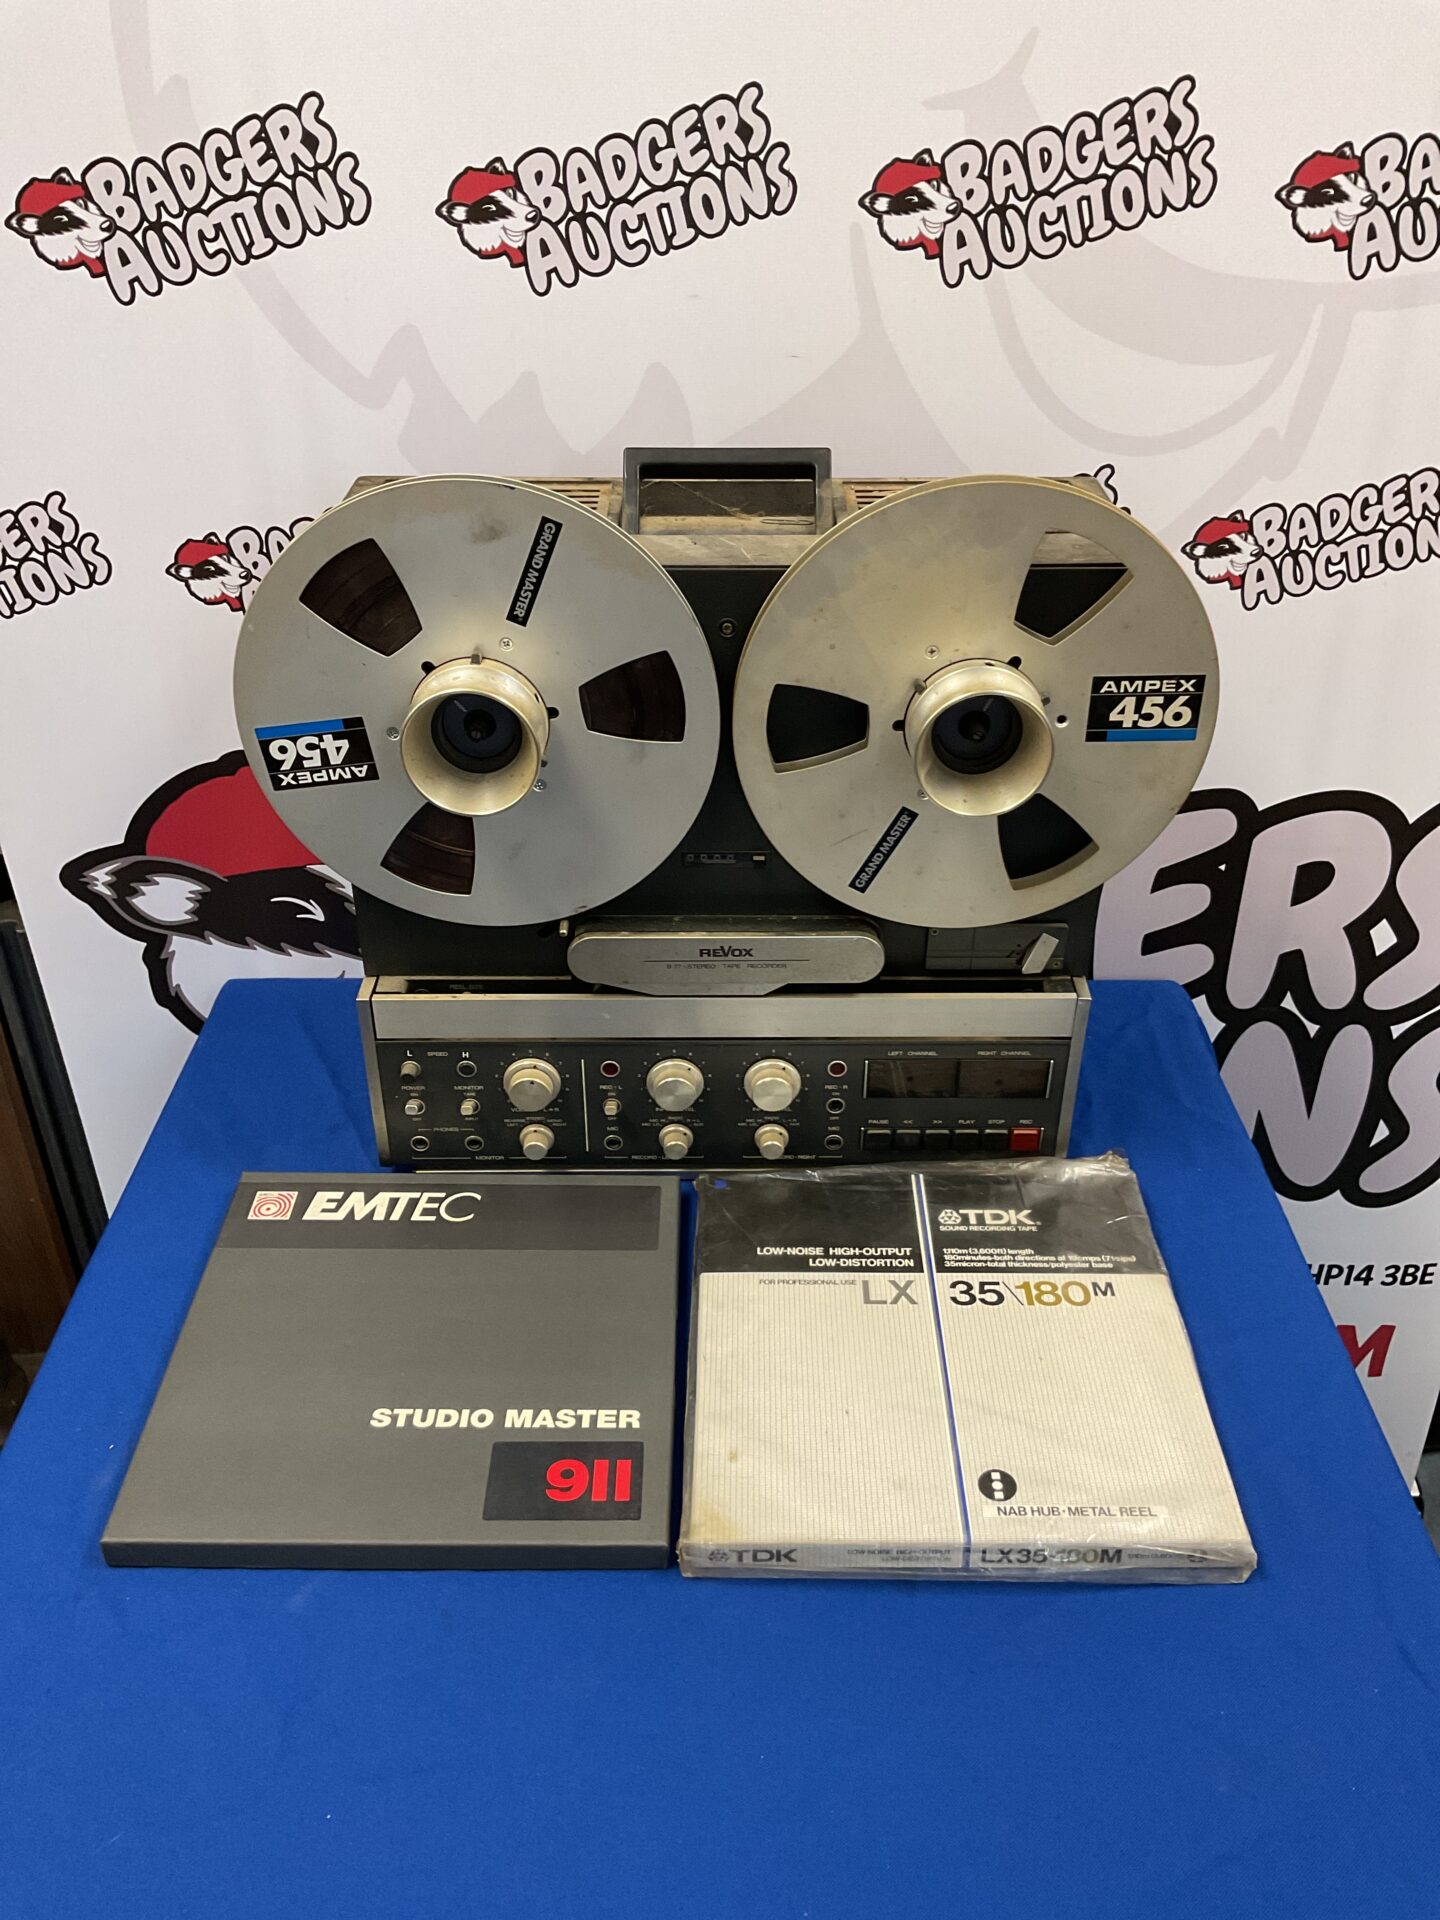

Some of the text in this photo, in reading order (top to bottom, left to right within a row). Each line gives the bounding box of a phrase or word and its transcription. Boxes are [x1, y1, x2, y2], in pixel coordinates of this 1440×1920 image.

[516, 81, 772, 228] BADGERS
[941, 75, 1199, 217] BADGERS
[82, 91, 337, 236] BADGERS
[522, 141, 797, 296] AUCTIONS
[941, 135, 1217, 287] AUCTIONS
[103, 152, 371, 304] AUCTIONS
[1250, 467, 1440, 559] BADGER
[531, 522, 556, 569] GRAND
[1100, 679, 1197, 693] AMPEX
[1109, 695, 1192, 728] 456
[269, 734, 350, 771] 456
[277, 765, 368, 786] AMPEX
[855, 852, 884, 887] GRAND
[302, 1191, 481, 1222] EMTEC
[959, 1209, 1035, 1225] TDK
[757, 1247, 912, 1256] LOW-NOISE HIGH-OUTPUT
[809, 1258, 914, 1267] LOW-DISTORTION
[1007, 1261, 1090, 1269] thickness/polyester
[1380, 1263, 1438, 1287] 3BE
[862, 1280, 918, 1304] LX
[370, 1408, 641, 1429] STUDIO MASTER
[546, 1459, 632, 1502] 911
[997, 1506, 1027, 1517] NAB
[1120, 1506, 1157, 1517] REEL
[735, 1549, 797, 1563] TDK
